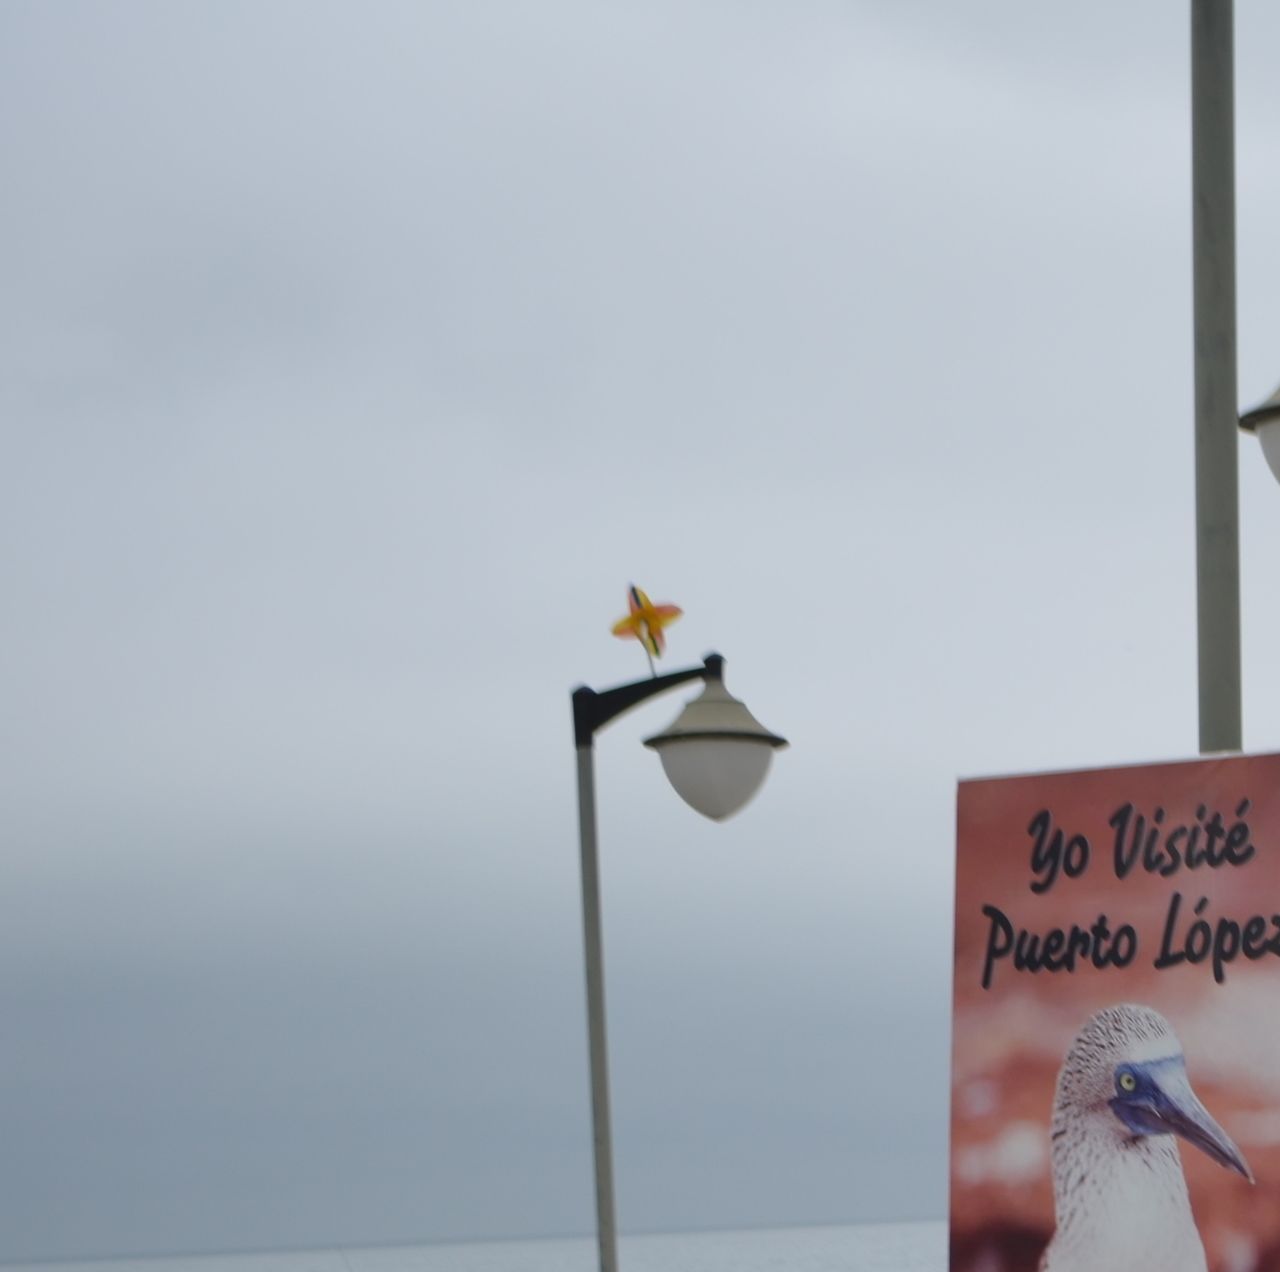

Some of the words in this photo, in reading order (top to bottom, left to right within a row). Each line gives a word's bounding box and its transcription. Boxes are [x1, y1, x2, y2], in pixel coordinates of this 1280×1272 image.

[1027, 808, 1089, 894] Yo
[1109, 798, 1255, 881] Visité
[981, 903, 1138, 990] Puerto
